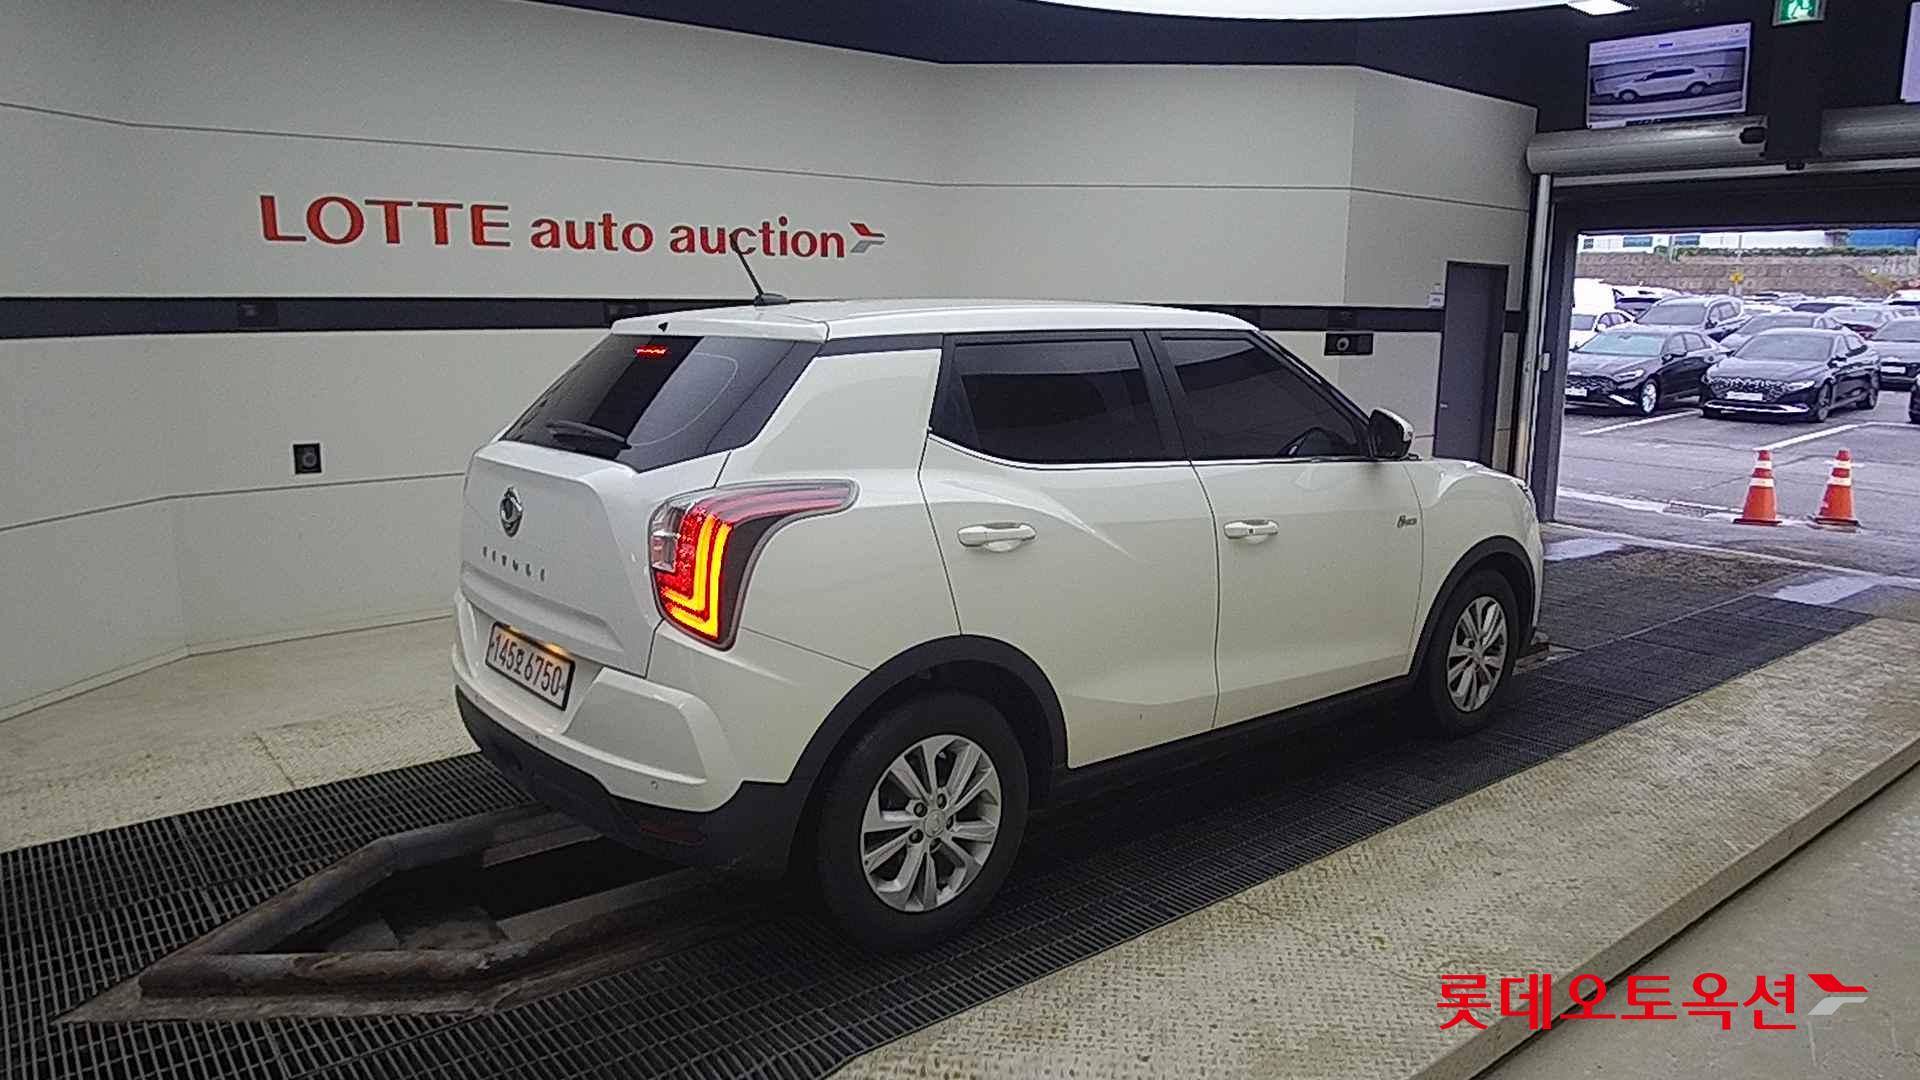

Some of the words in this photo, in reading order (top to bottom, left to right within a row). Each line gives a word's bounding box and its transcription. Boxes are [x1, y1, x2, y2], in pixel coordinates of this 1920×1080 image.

[260, 195, 510, 247] LOTTE
[531, 213, 655, 252] auto
[669, 216, 845, 258] auction
